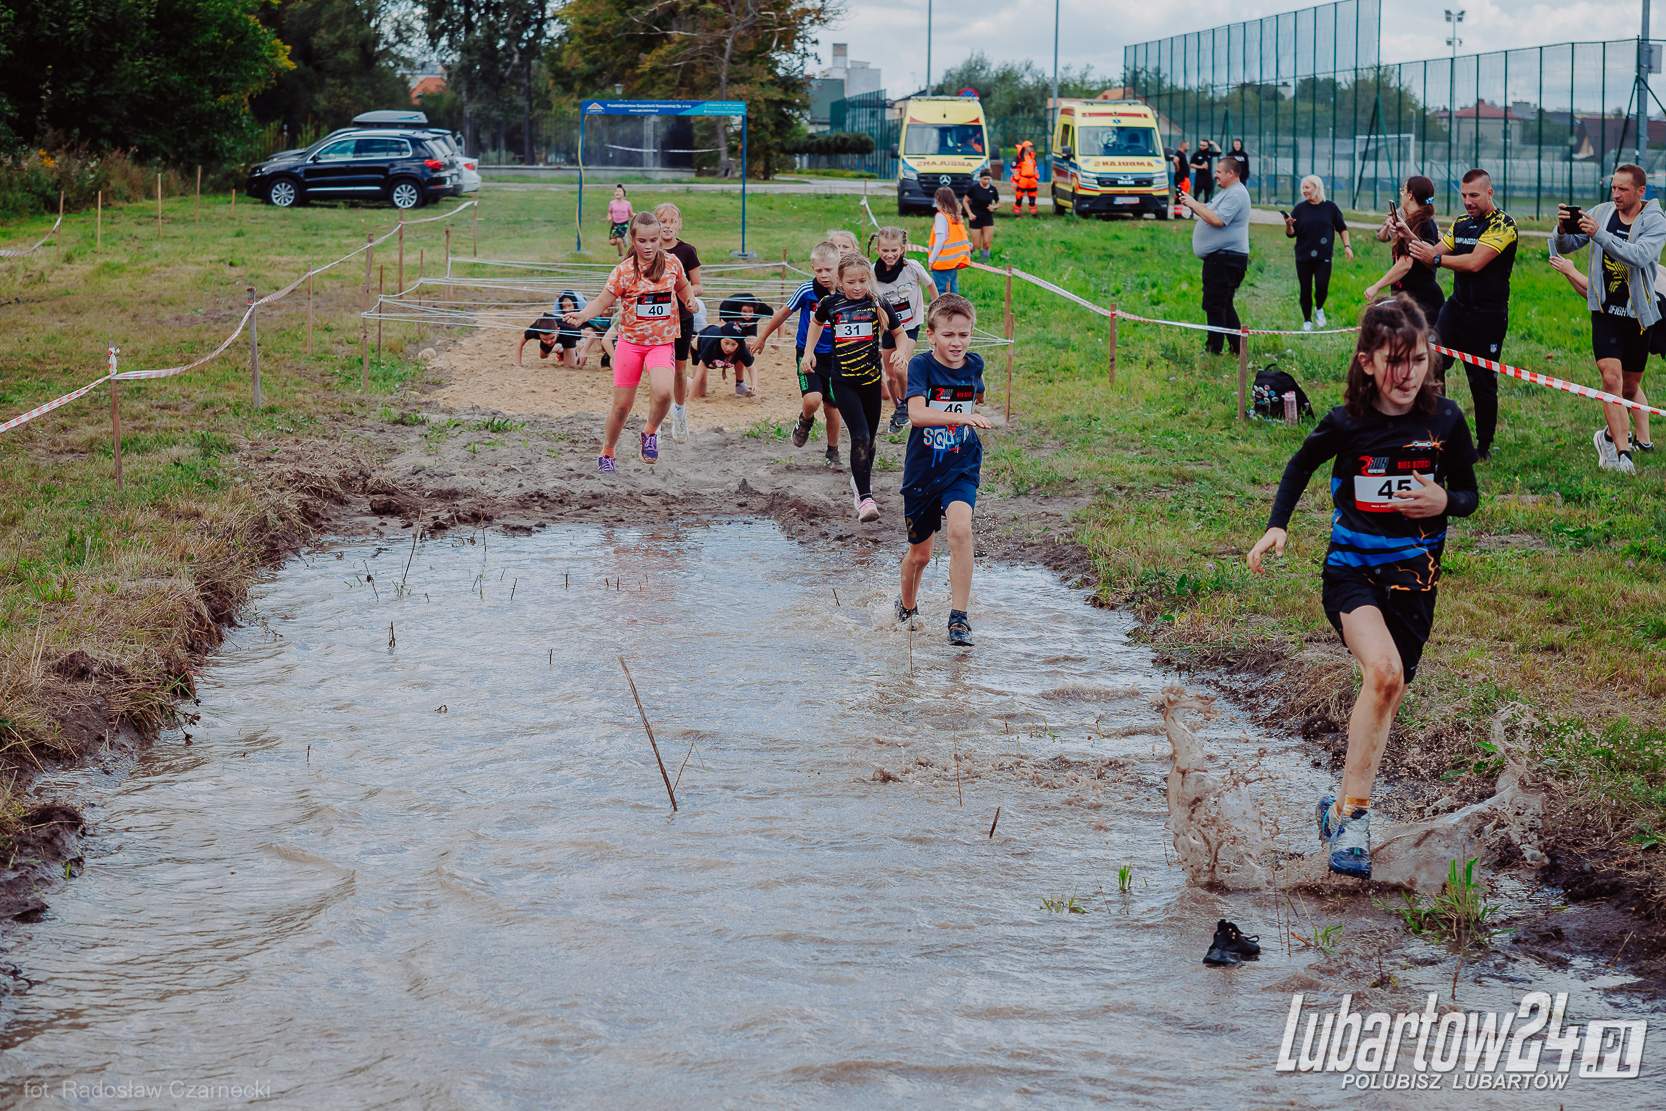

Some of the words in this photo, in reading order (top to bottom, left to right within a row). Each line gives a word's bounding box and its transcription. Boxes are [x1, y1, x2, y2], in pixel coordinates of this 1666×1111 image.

[648, 305, 664, 316] 40
[844, 325, 860, 336] 31
[944, 403, 963, 414] 46
[1377, 479, 1412, 500] 45
